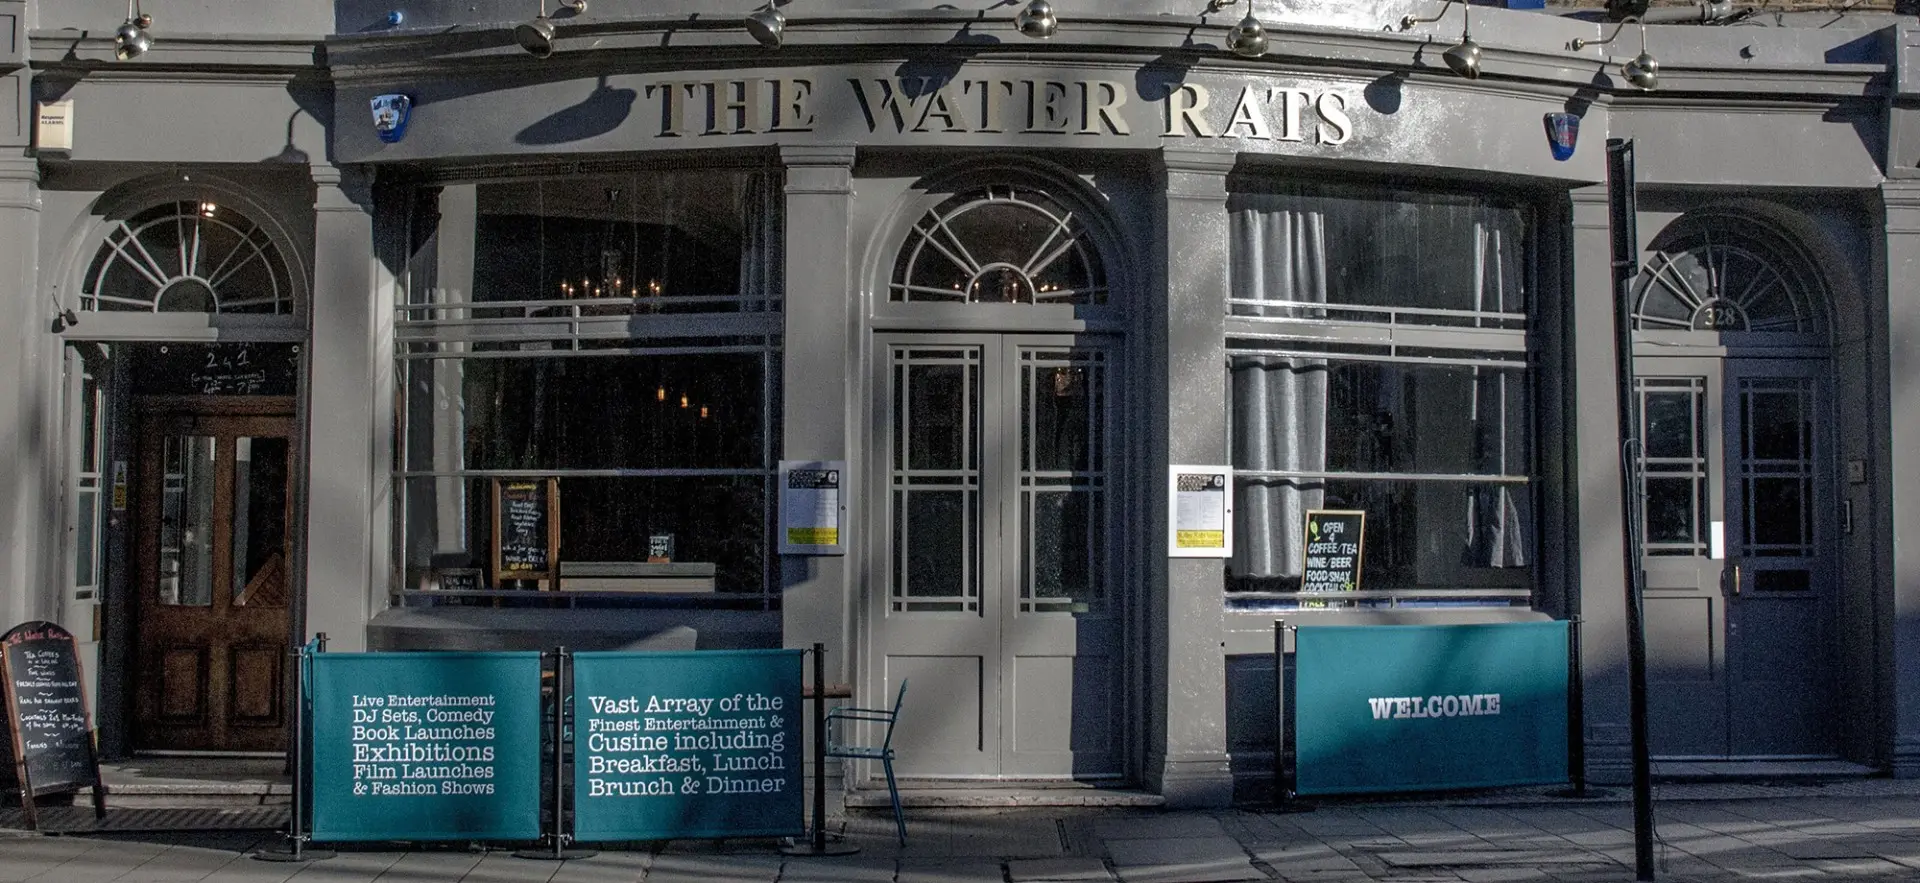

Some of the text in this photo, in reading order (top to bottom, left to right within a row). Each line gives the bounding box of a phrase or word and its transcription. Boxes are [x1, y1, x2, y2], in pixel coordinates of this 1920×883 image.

[647, 77, 1353, 145] THE WATER RATS
[1704, 308, 1736, 325] 328
[1322, 522, 1344, 533] OPEN
[1329, 532, 1335, 542] 4
[1307, 557, 1352, 568] WINE/BEER
[353, 694, 496, 707] Live Entertainment
[588, 693, 784, 716] Vast Array of the
[1368, 693, 1500, 719] WELCOME
[353, 708, 495, 725] DJ Sets, Comedy
[588, 715, 784, 732] Finest Entertainment &
[352, 725, 495, 741] Book Launches
[588, 731, 785, 752] Cusine including
[352, 743, 495, 763] Exhibitions
[353, 763, 494, 779] Film Launches
[589, 753, 785, 775] Breakfast, Lunch
[353, 781, 495, 795] & Fashion Shows
[589, 776, 786, 797] Brunch & Dinner
